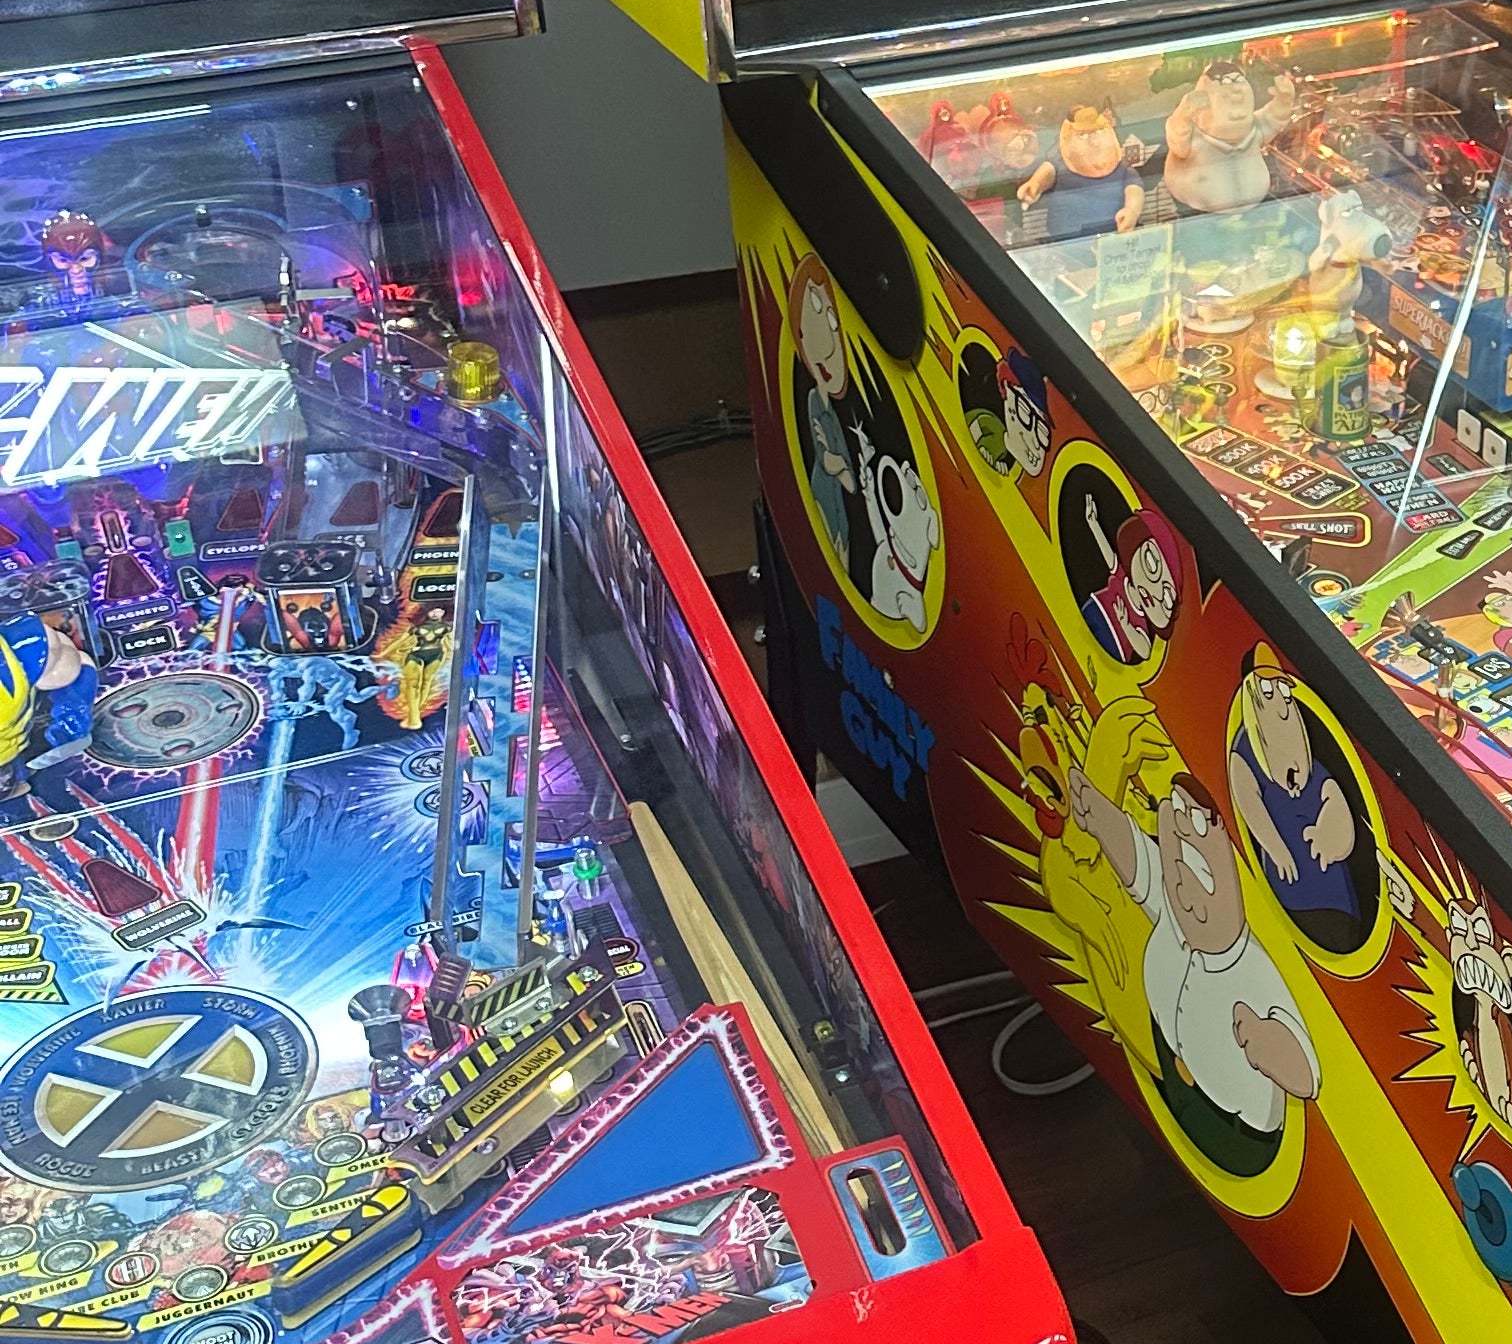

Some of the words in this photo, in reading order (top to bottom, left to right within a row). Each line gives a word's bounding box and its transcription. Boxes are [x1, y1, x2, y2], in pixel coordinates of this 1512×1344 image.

[1217, 442, 1258, 463] 300K
[1274, 467, 1316, 489] 500K
[1319, 522, 1354, 535] SHOT
[104, 604, 170, 623] MAGNETO
[125, 635, 167, 651] LOCK
[124, 908, 195, 943] WOLVERINE
[100, 997, 169, 1024] XAVIER
[202, 996, 259, 1020] STORM
[469, 1086, 502, 1116] CLEAR
[500, 1072, 522, 1100] FOR
[518, 1046, 557, 1084] LAUNCH
[33, 1151, 99, 1180] ROGUE
[38, 1276, 79, 1296] KING
[100, 1289, 141, 1310] CLUB
[154, 1287, 257, 1325] JUGGERNAUT
